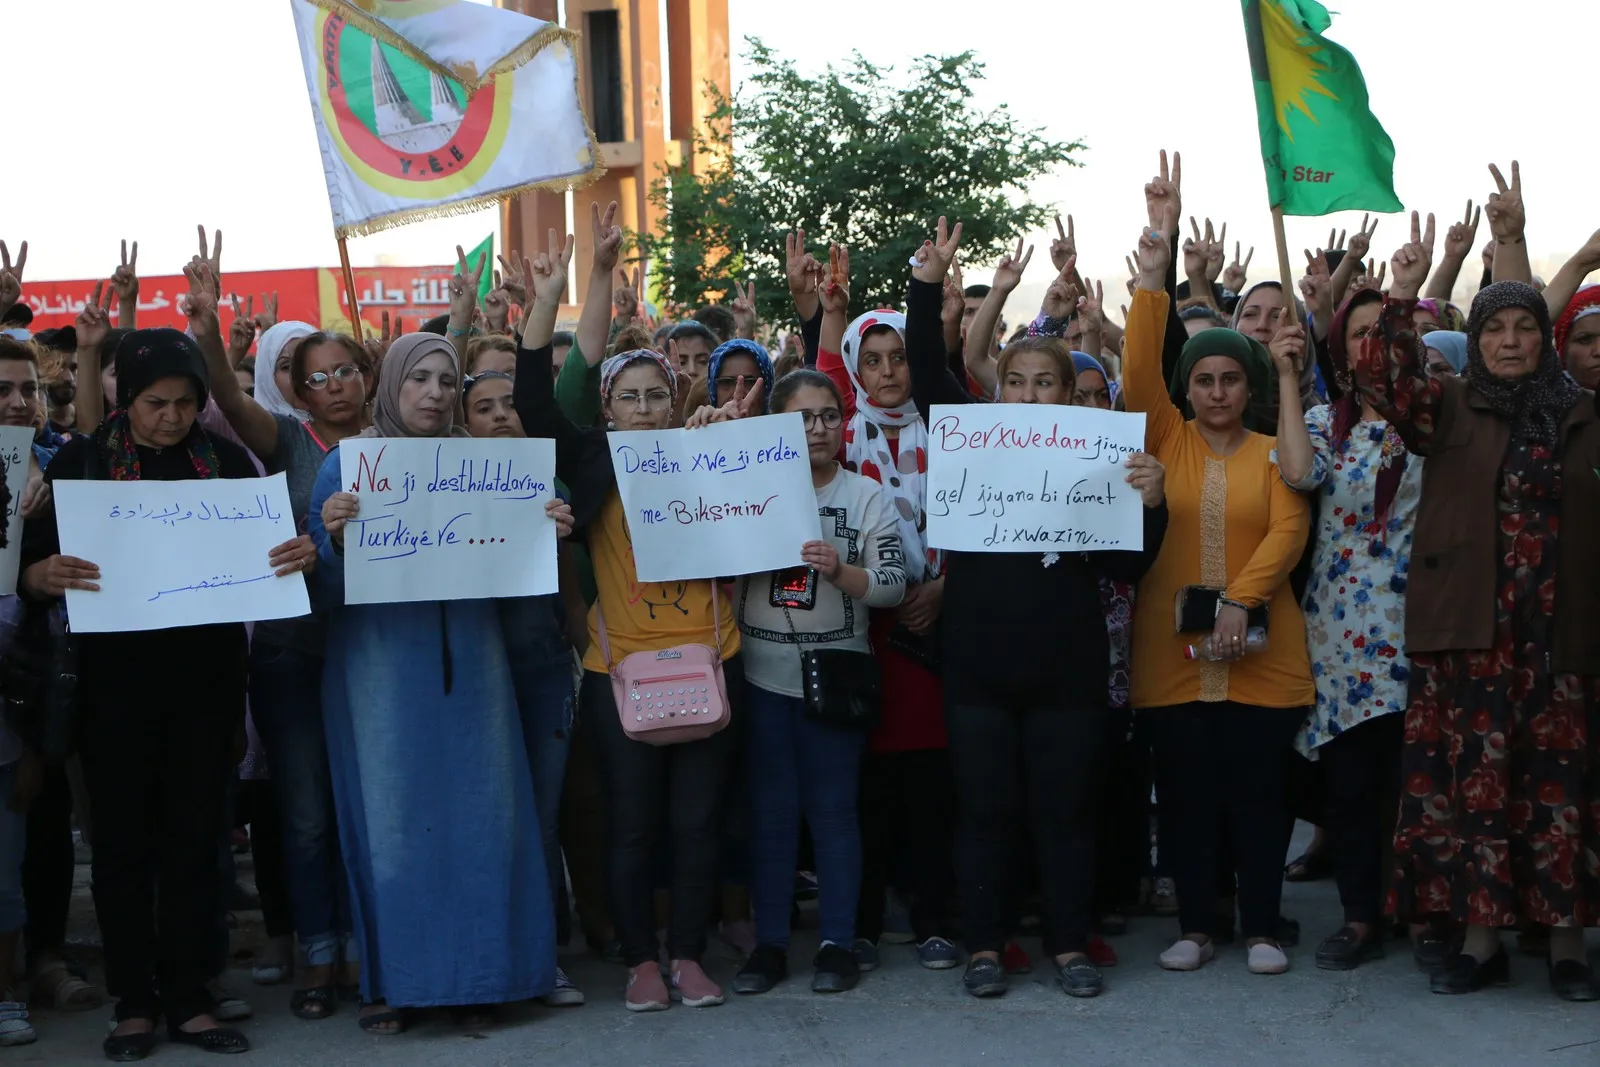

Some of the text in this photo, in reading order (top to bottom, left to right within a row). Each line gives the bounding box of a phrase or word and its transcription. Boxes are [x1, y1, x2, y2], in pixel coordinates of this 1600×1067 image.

[1292, 165, 1335, 184] Star
[931, 415, 1088, 452] Berxwedan
[616, 440, 682, 475] Destên
[721, 449, 750, 474] ji
[756, 436, 801, 465] erdên
[349, 443, 549, 507] Na ji desthilatdariya
[928, 467, 968, 517] gel
[1039, 469, 1058, 503] bi
[197, 493, 282, 524] بالنضال
[640, 507, 668, 525] me
[837, 508, 846, 528] NEW
[836, 528, 858, 540] NEW
[753, 628, 792, 643] CHANEL
[795, 633, 819, 643] NEW
[821, 629, 854, 642] CHANEL
